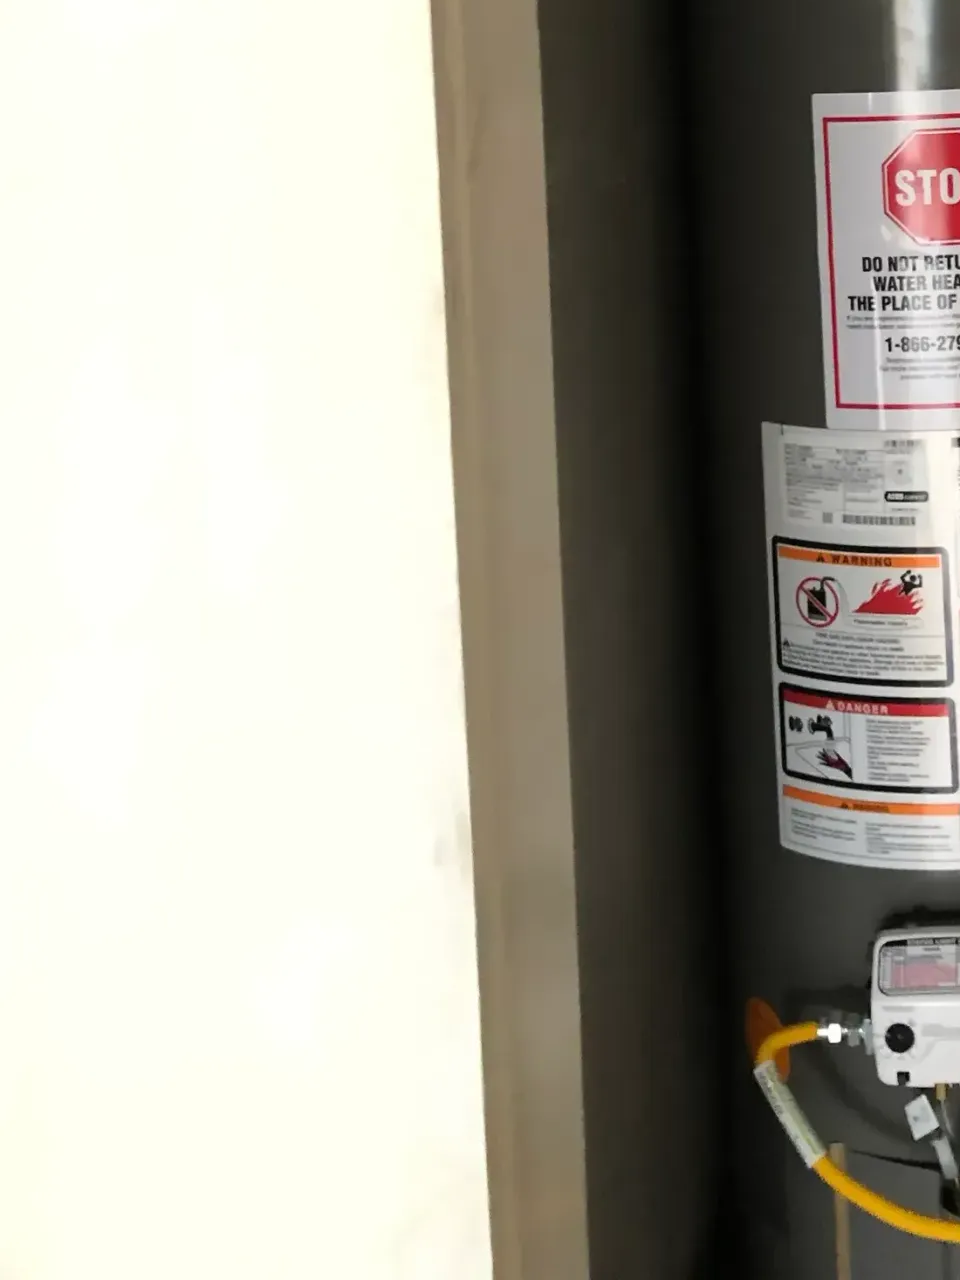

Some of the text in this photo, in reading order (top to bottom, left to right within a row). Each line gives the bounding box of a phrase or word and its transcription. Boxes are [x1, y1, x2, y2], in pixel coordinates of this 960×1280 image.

[862, 256, 883, 272] DO
[888, 255, 919, 272] NOT
[873, 275, 927, 292] WATER
[848, 295, 876, 311] THE
[881, 294, 932, 311] PLACE
[936, 293, 957, 310] OF
[831, 554, 892, 567] WARNING
[837, 702, 889, 715] DANGER
